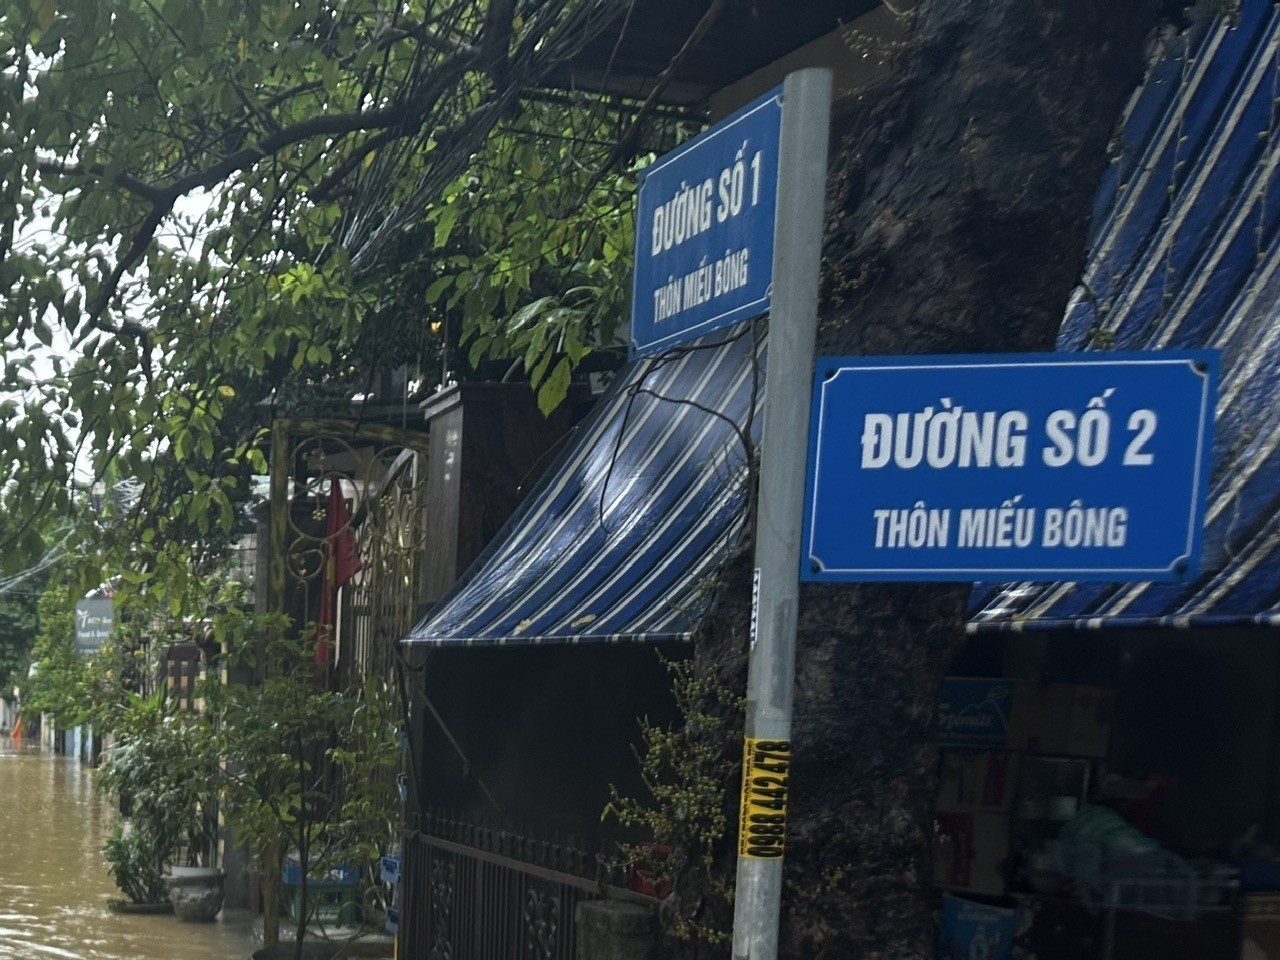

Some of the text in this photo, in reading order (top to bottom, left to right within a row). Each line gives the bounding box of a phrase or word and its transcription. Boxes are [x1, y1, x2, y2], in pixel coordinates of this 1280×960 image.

[651, 138, 763, 257] ĐƯỜNG SỐ 1
[653, 248, 749, 323] THÔN MIẾU BÔNG
[861, 387, 1158, 469] ĐƯỜNG SỐ 2
[873, 494, 1128, 548] THÔN MIẾU BÔNG
[747, 741, 791, 857] 0988 442 478
